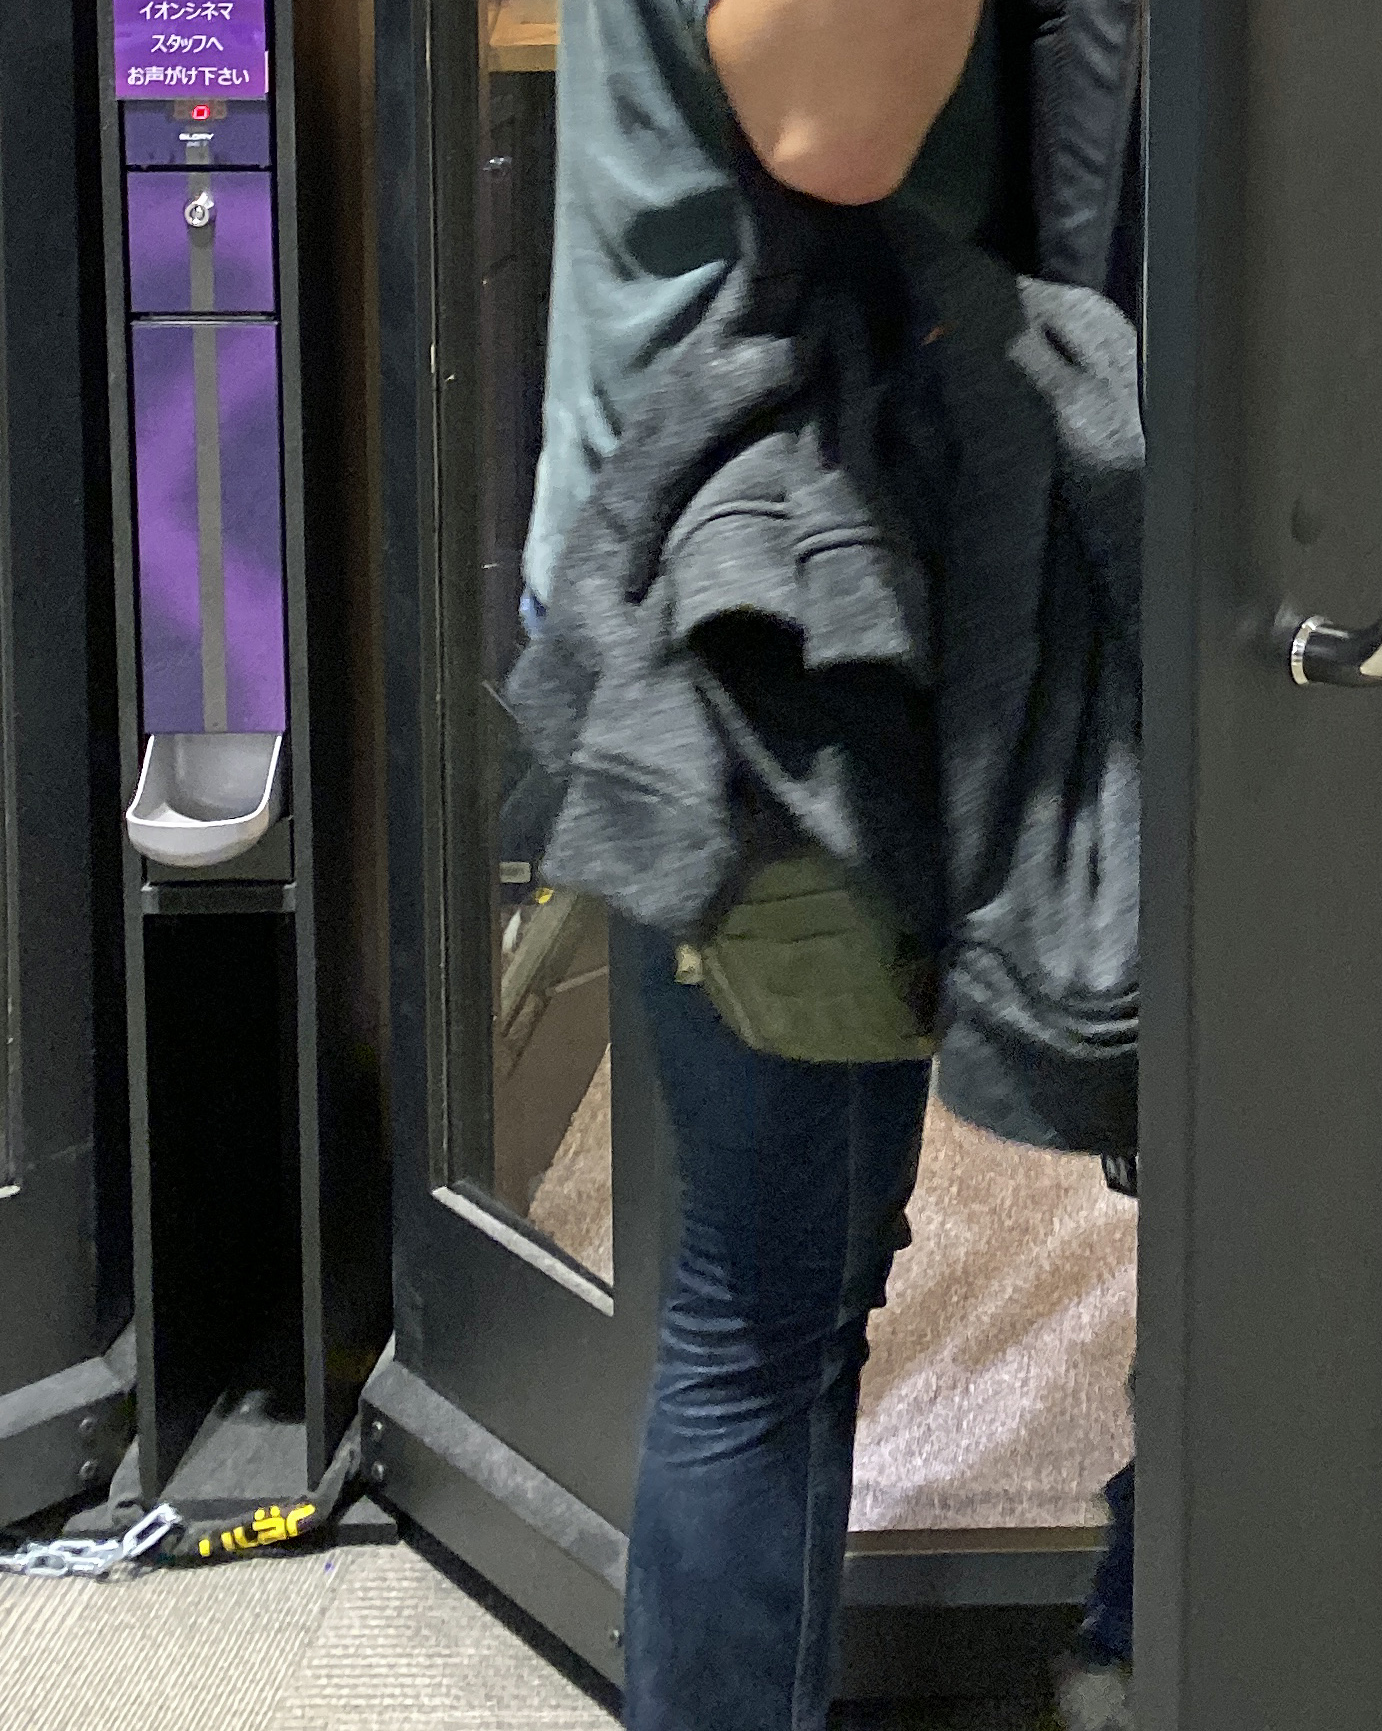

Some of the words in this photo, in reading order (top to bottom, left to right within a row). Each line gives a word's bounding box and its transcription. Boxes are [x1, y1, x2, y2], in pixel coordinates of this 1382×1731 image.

[139, 2, 234, 20] イオンシネマ
[150, 34, 224, 53] スタッフへ
[127, 66, 250, 86] お声がけ下さい
